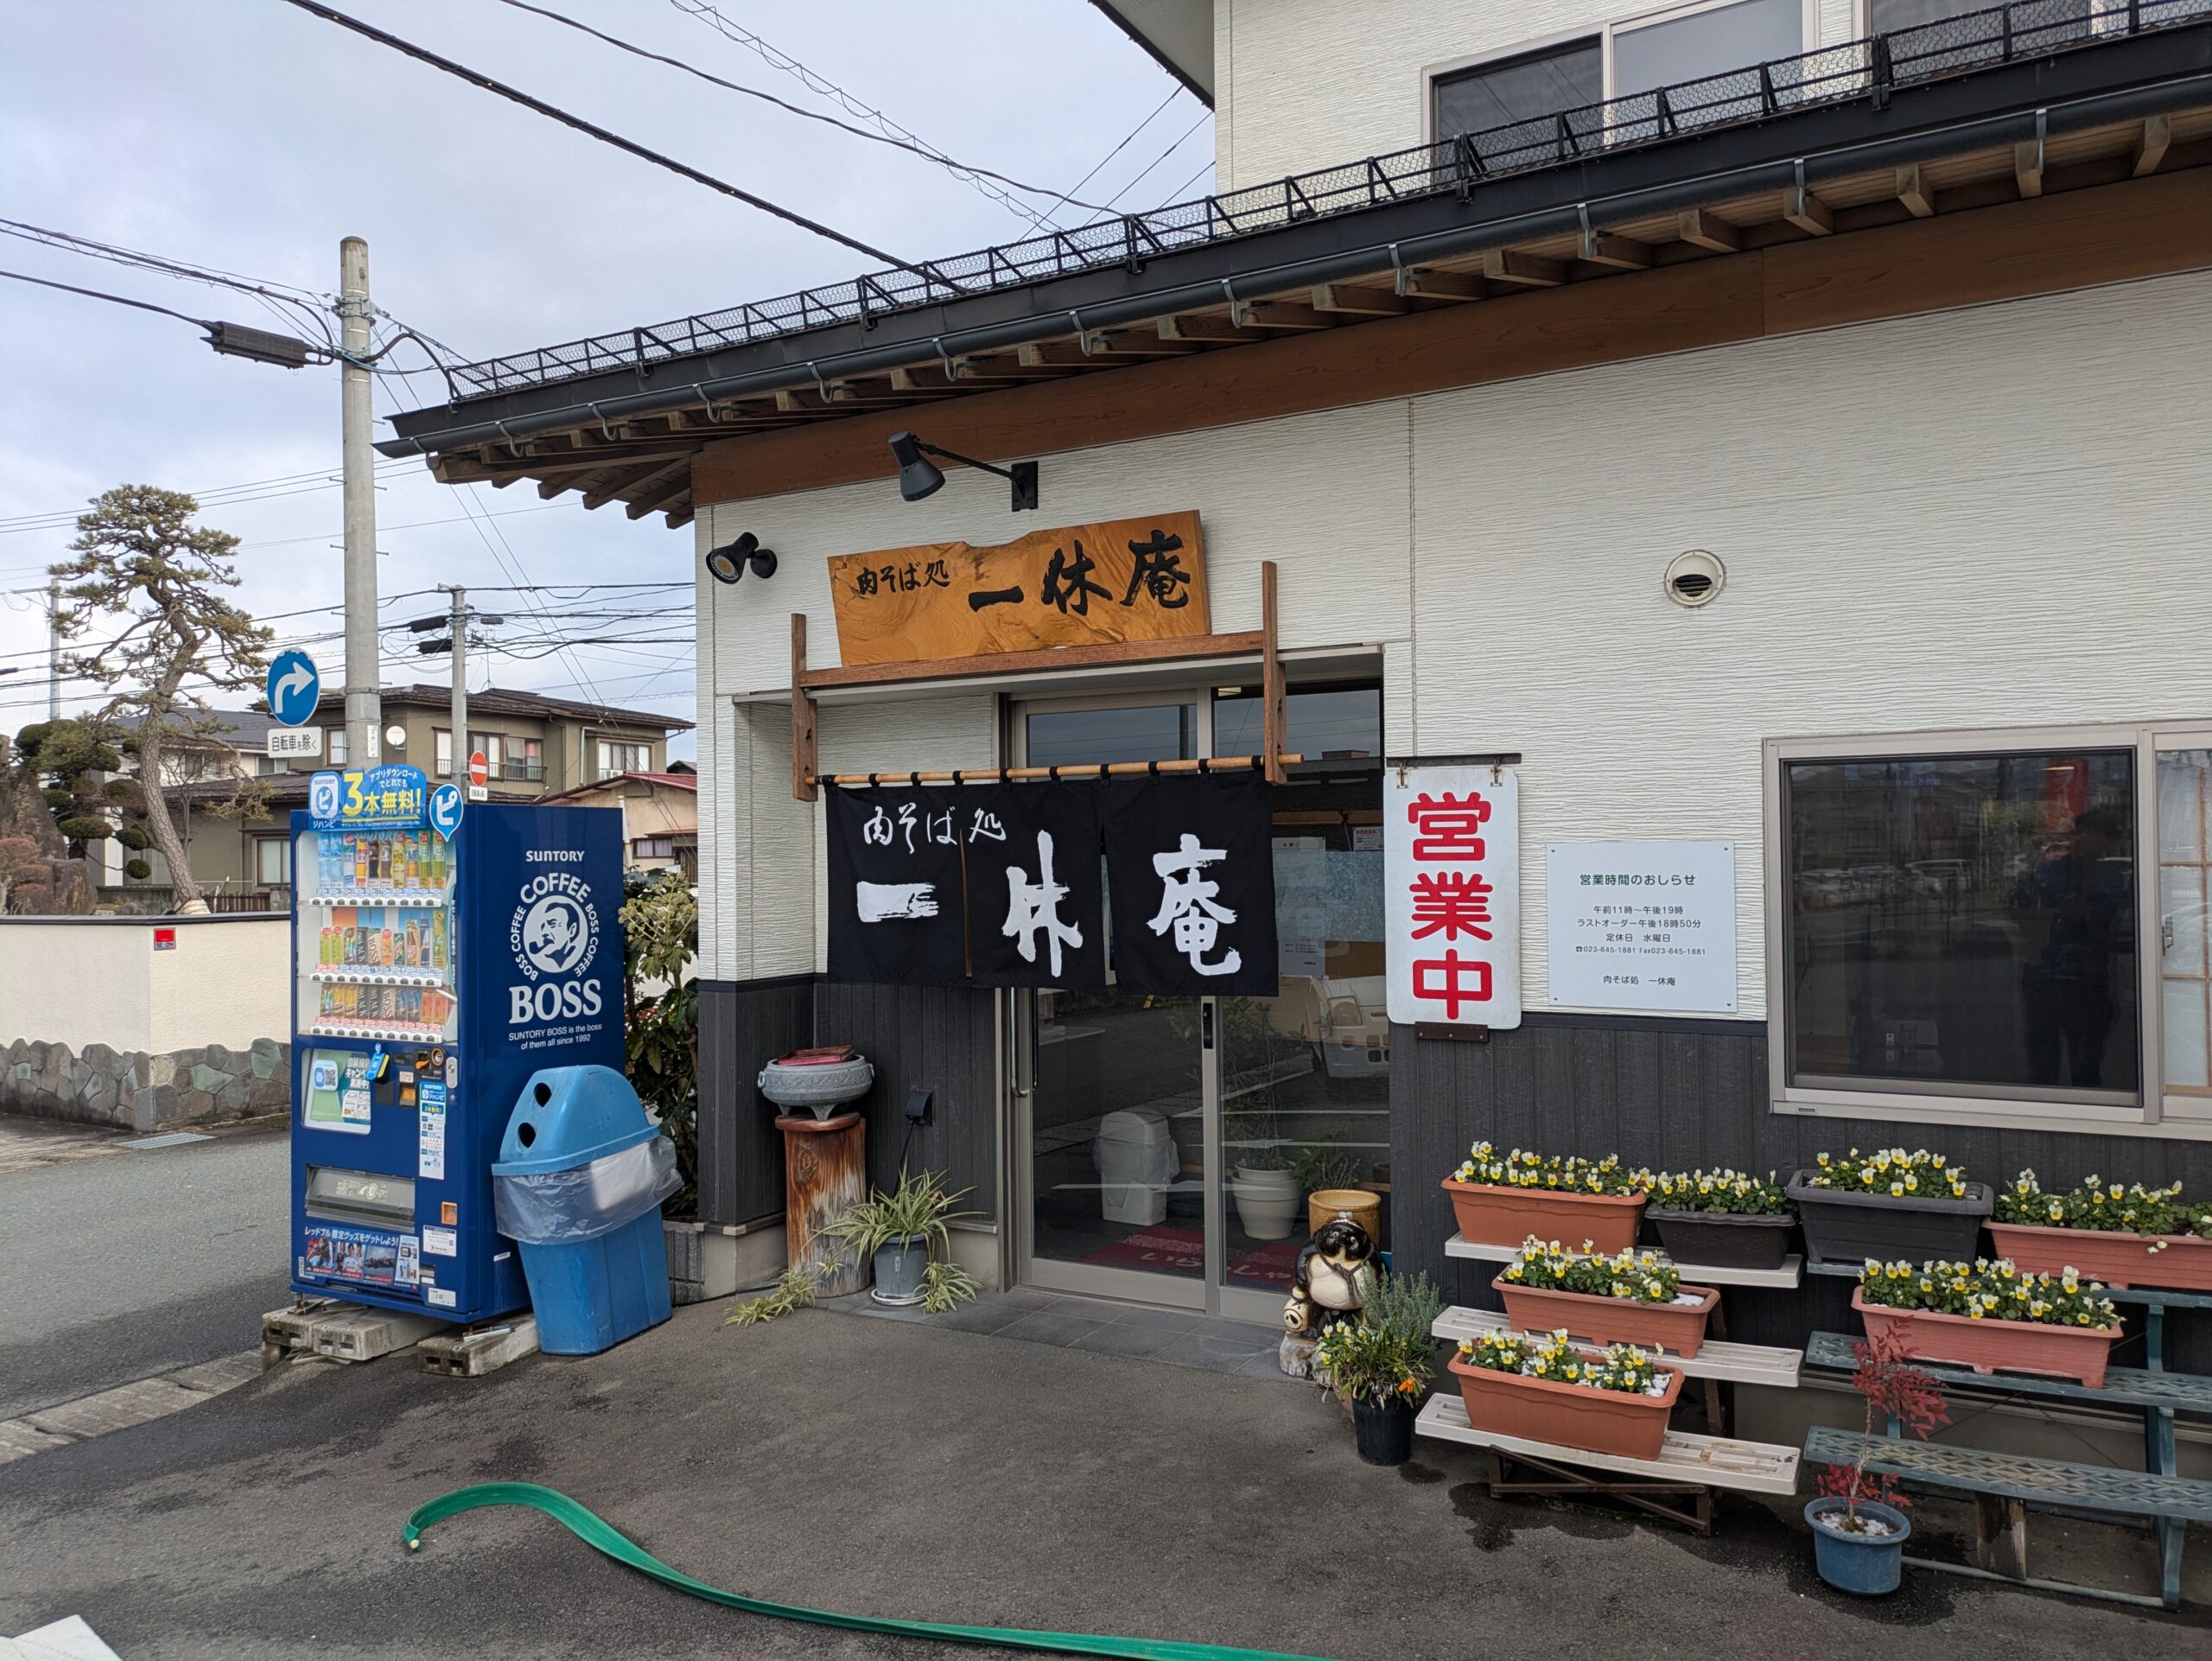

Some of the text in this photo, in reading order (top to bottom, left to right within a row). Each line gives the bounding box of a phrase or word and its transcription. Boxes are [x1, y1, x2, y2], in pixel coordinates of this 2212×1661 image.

[856, 530, 1191, 615] 肉そば処 一休庵
[272, 734, 317, 751] 自転車を除く
[369, 767, 418, 782] アプリダウンロード
[864, 803, 1006, 854] 肉そば処
[525, 850, 585, 862] SUNTORY
[520, 873, 591, 904] COFFEE
[1580, 874, 1696, 886] 営業時間のおしらせ
[856, 830, 1243, 977] 一休庵
[1408, 792, 1493, 1020] 営業中
[1577, 919, 1701, 929] ラストオーダー午後18時50分
[511, 906, 539, 981] BOSS COFFEE
[574, 903, 600, 977] BOSS COFFEE
[1605, 933, 1671, 943] 定休日 水曜日
[369, 936, 379, 963] BOSS
[1603, 975, 1676, 986] 肉そば処 一休庵
[509, 978, 602, 1023] BOSS
[509, 1028, 546, 1041] SUNTORY
[547, 1026, 568, 1036] BOSS
[569, 1025, 575, 1034] is
[575, 1024, 586, 1033] the
[521, 1041, 528, 1050] of
[529, 1040, 546, 1048] them
[575, 1034, 591, 1042] 1992
